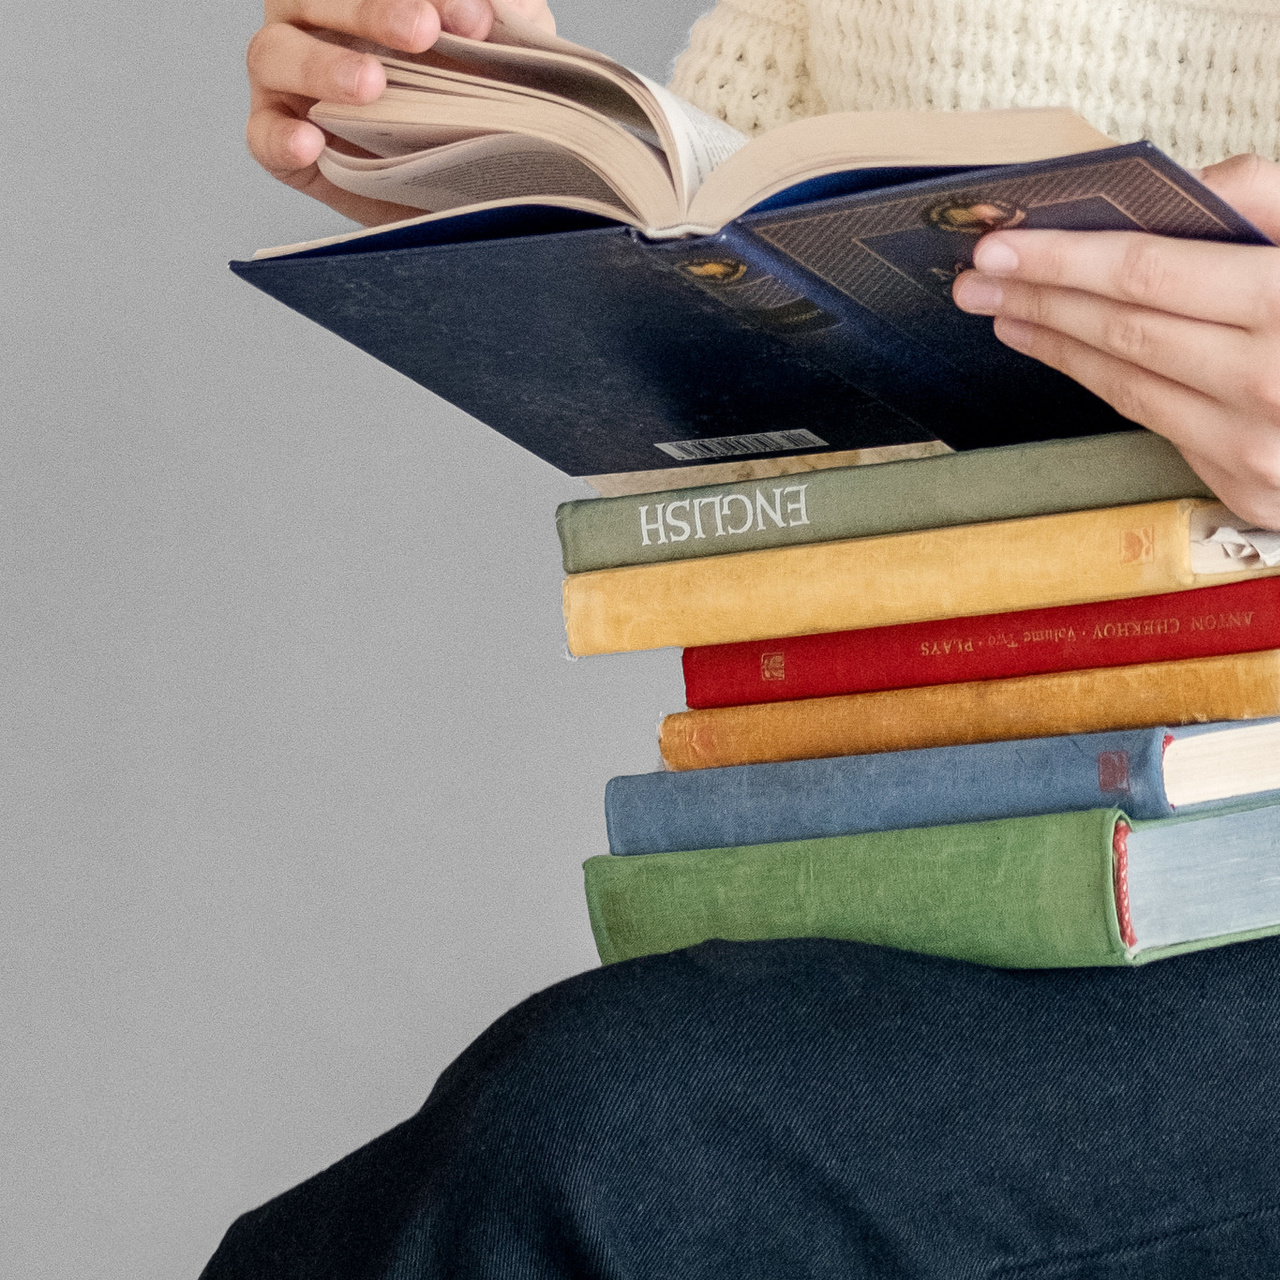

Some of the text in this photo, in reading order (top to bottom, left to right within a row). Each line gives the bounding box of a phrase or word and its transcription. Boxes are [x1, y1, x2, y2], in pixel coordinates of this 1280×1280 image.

[638, 484, 810, 546] ENGLISH
[1092, 618, 1180, 639] CHEKHOV
[1189, 611, 1254, 632] ANTON
[1023, 626, 1077, 643] Volume
[920, 639, 974, 656] PLAYS
